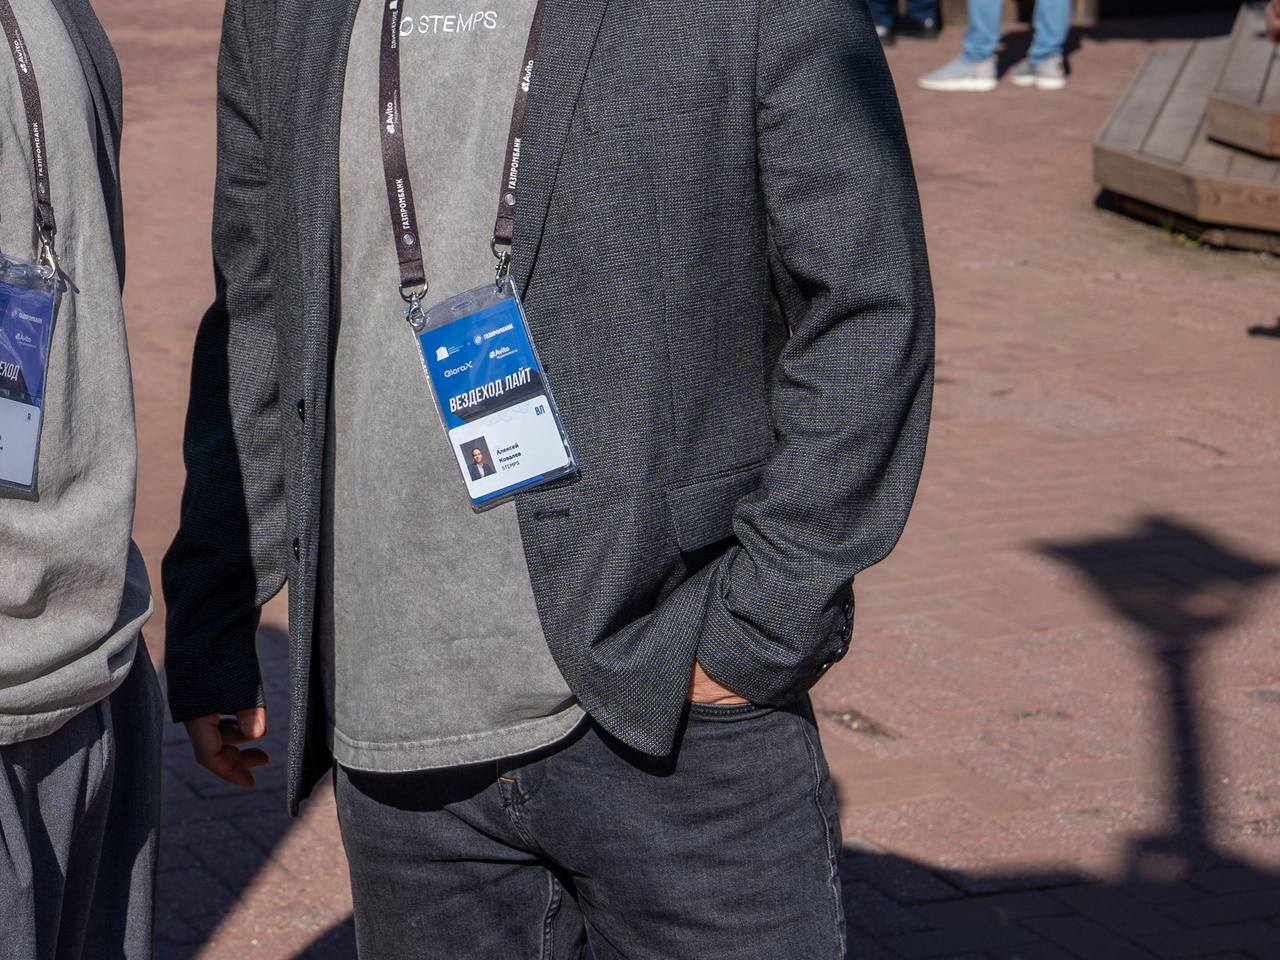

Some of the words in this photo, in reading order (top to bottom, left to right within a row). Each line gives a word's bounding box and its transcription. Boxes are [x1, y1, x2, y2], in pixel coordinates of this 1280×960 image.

[418, 10, 498, 34] STEMPS
[32, 122, 44, 177] ГАЗПРОМБАНК
[507, 137, 521, 189] ГАЗПРОМБАНК
[395, 178, 410, 230] ГАЗПРОМБАНК
[443, 361, 473, 378] GloraX
[449, 379, 504, 413] ВЕЗДЕХОД
[505, 367, 532, 392] ЛАЙТ
[496, 442, 519, 455] Алексей
[501, 460, 521, 471] STEMPS
